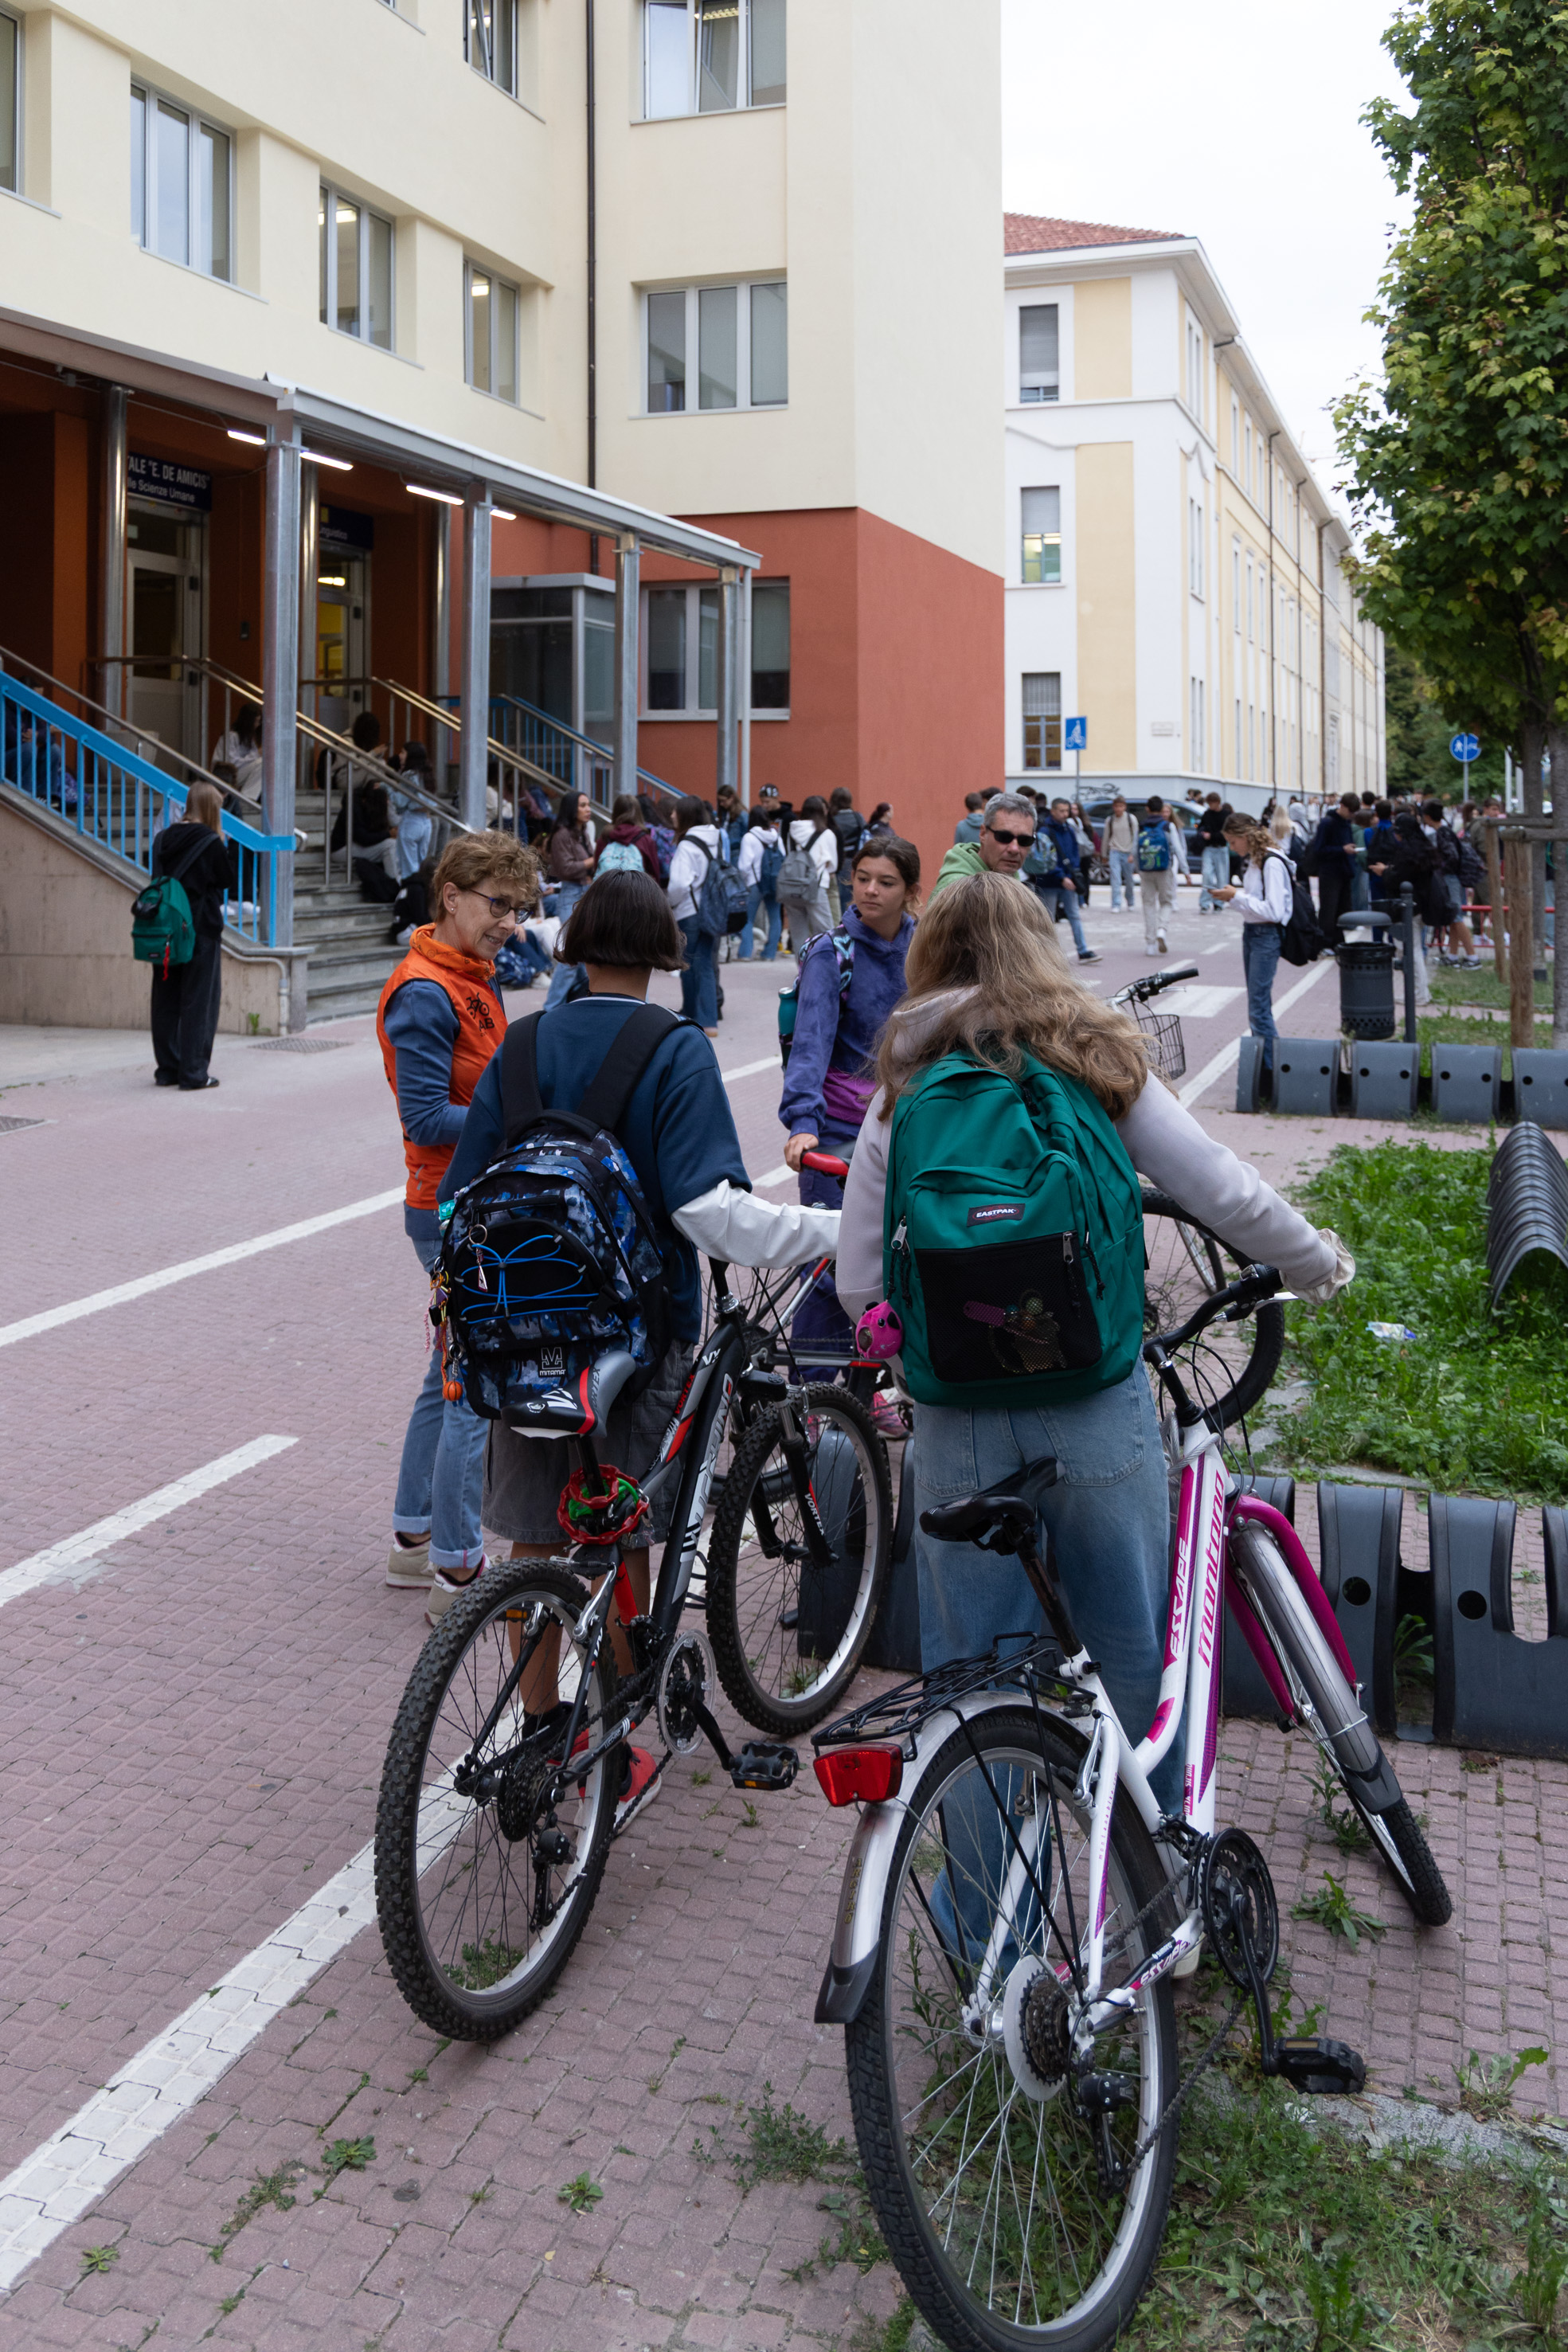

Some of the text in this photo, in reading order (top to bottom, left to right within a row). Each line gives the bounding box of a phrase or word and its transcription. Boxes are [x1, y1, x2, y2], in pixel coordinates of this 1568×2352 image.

[127, 455, 147, 475] ALE
[162, 464, 175, 482] DE
[176, 468, 210, 490] AMICIS"
[138, 479, 168, 497] Scienze
[169, 487, 196, 503] Umane
[976, 1208, 1015, 1218] EASTPAK
[674, 1373, 695, 1415] VORTEX
[804, 1493, 825, 1536] VORTEX
[1198, 1469, 1224, 1668] montana
